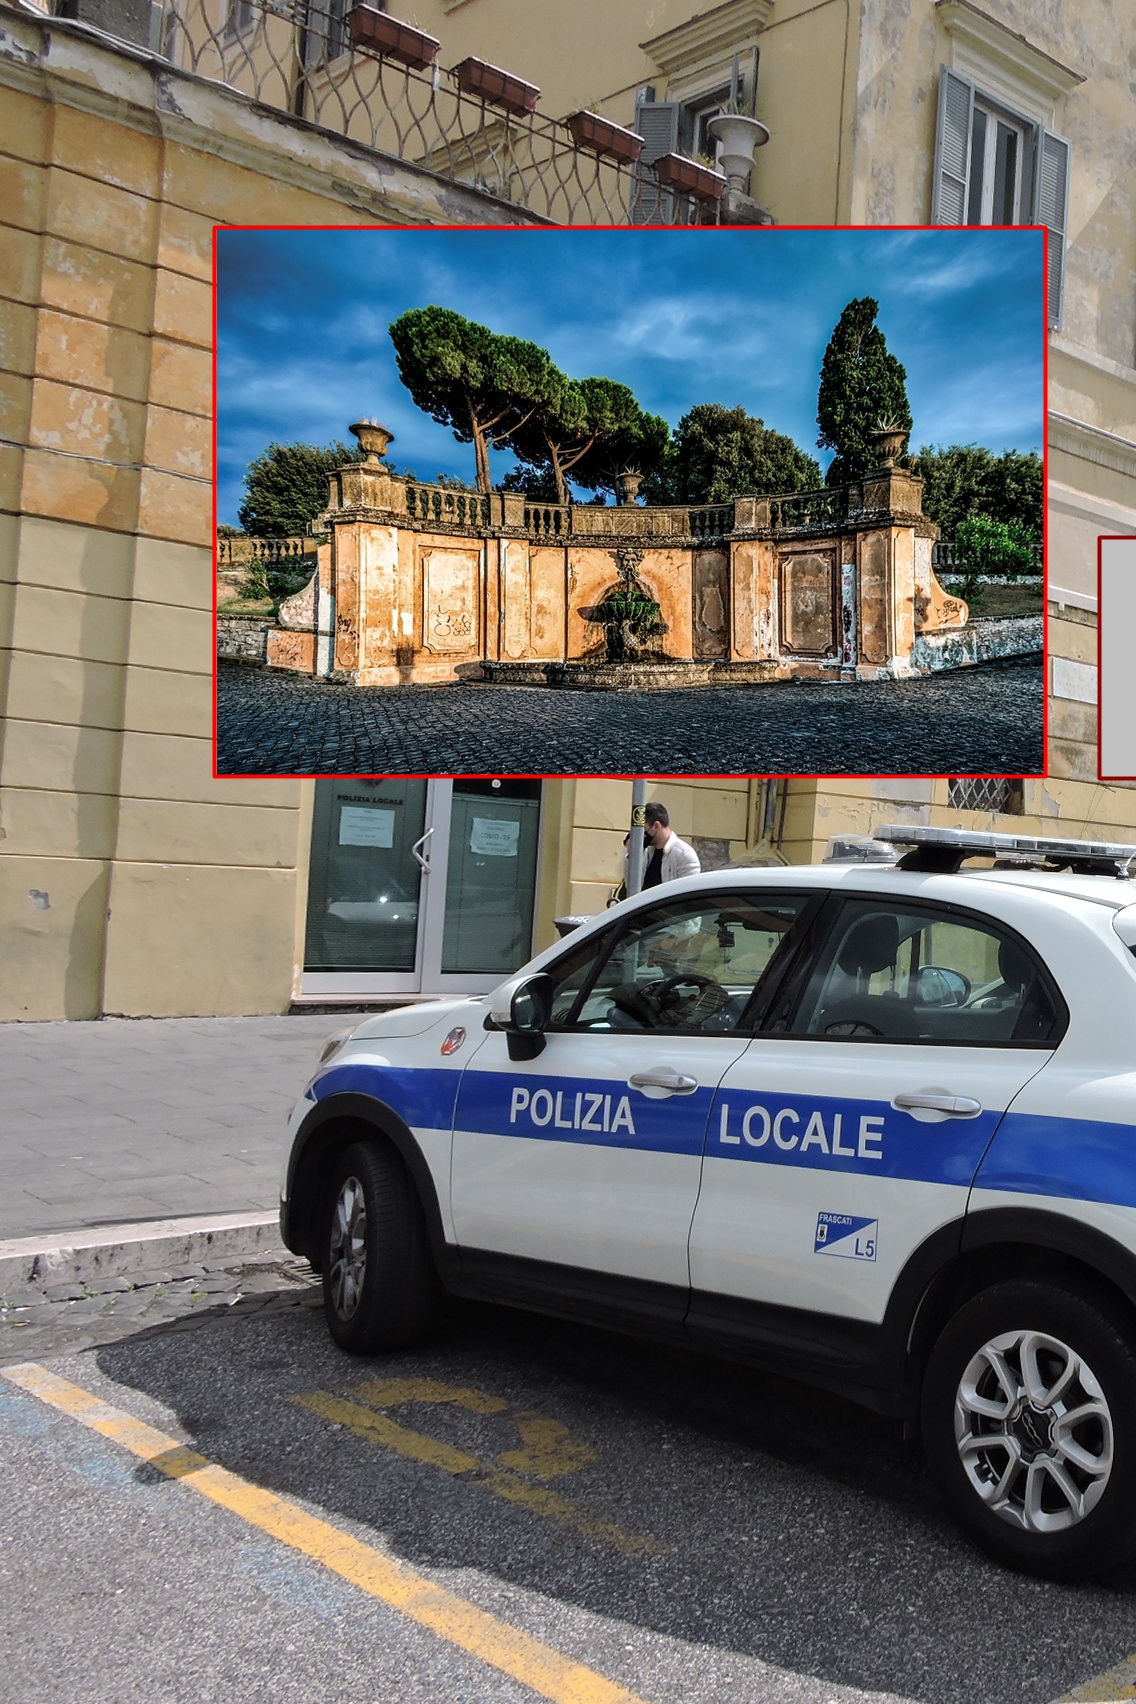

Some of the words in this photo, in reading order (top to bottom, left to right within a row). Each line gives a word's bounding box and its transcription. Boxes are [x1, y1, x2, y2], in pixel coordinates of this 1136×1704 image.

[337, 794, 371, 803] POLIZIA
[373, 796, 404, 806] LOCALE
[510, 1087, 636, 1135] POLIZIA
[719, 1104, 885, 1160] LOCALE
[818, 1213, 853, 1226] FRASCATI
[855, 1237, 875, 1258] L5
